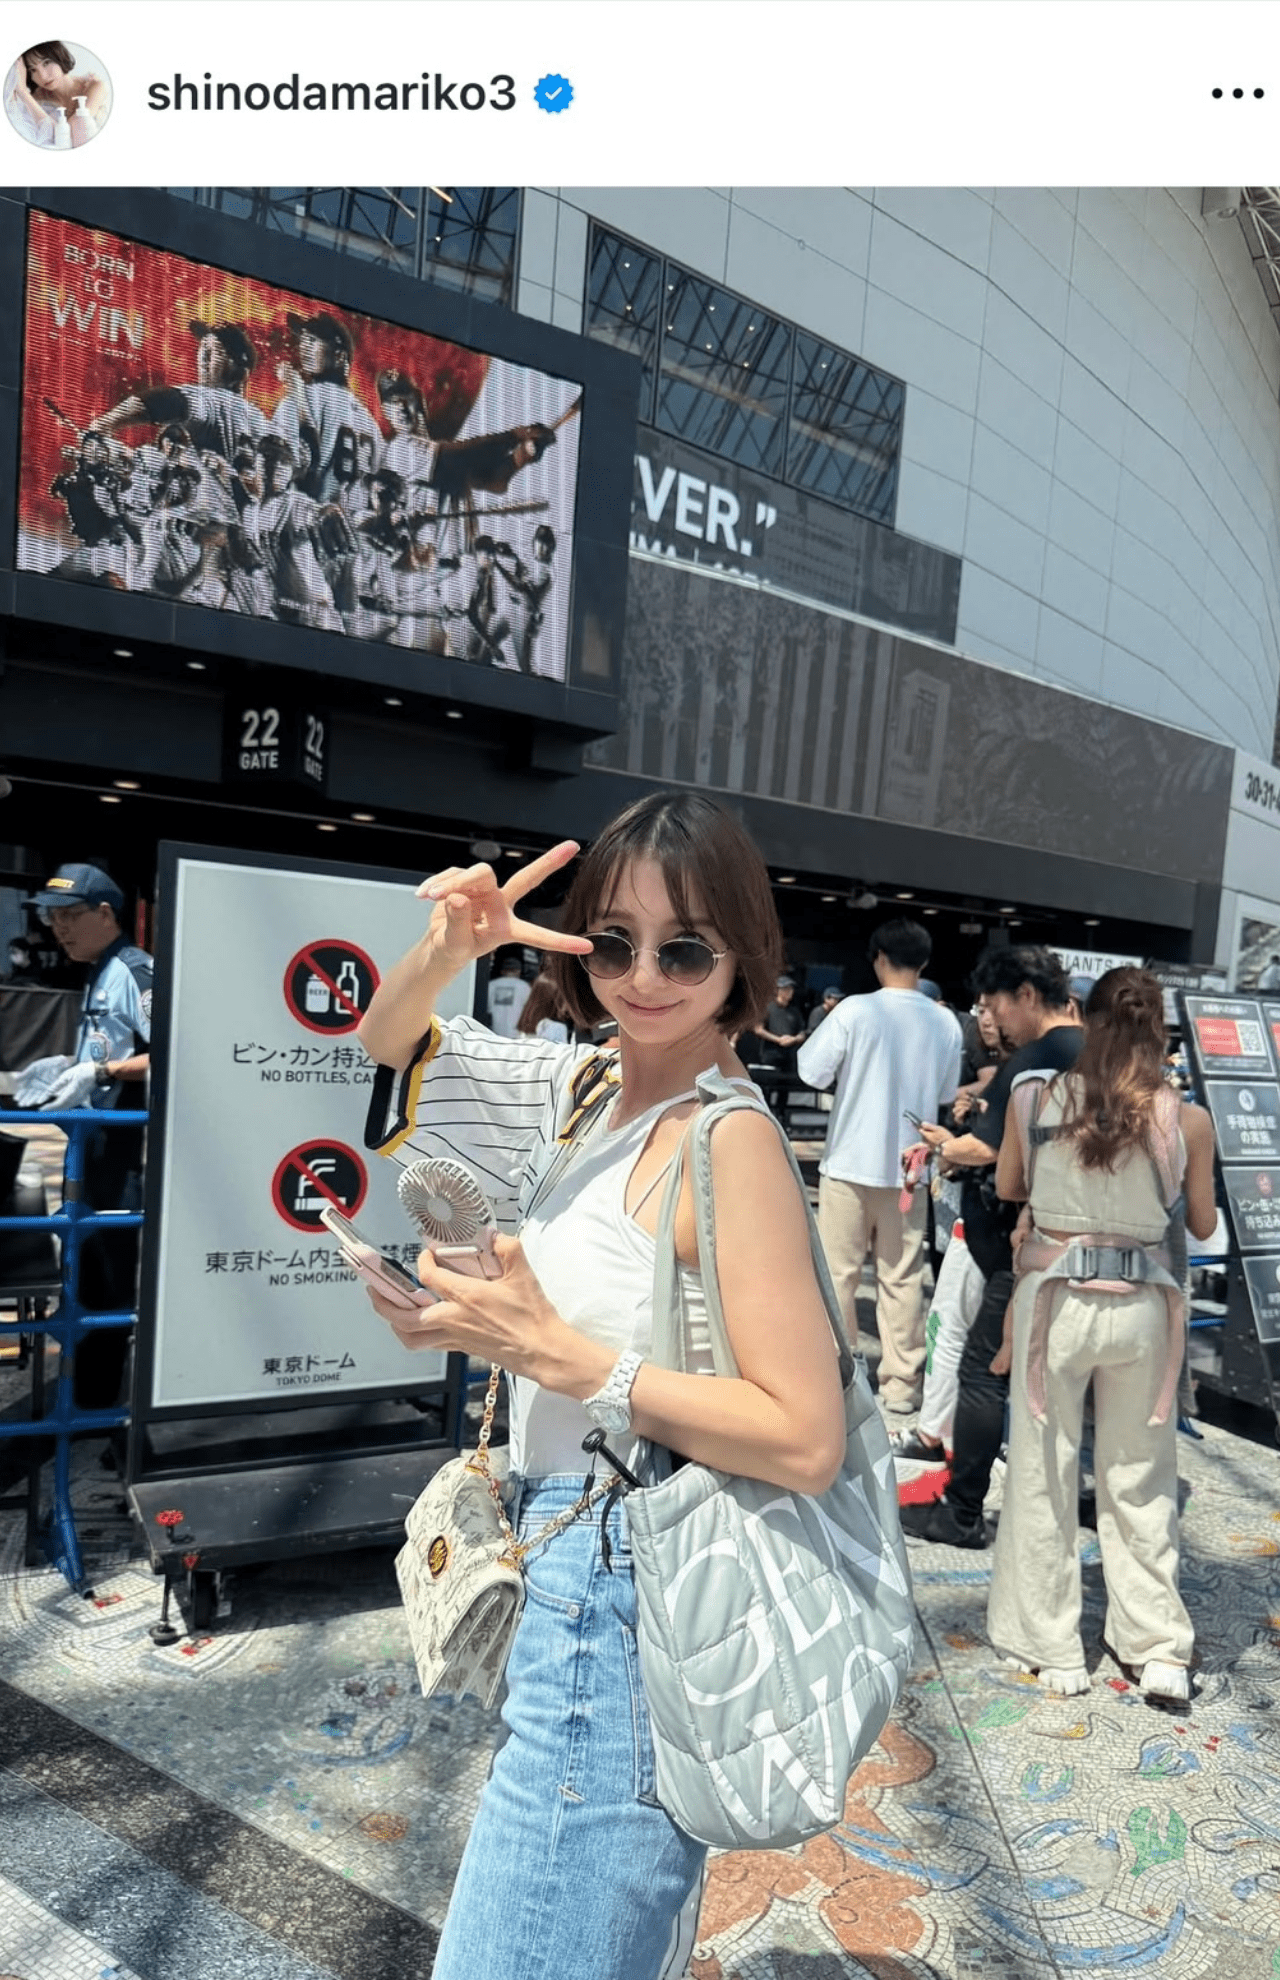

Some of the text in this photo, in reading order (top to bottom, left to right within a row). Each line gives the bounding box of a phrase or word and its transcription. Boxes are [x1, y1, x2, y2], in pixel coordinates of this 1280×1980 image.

[64, 244, 134, 281] BORN
[47, 289, 144, 349] WIN
[631, 455, 777, 558] VER.”
[241, 708, 279, 747] 22
[306, 715, 324, 759] 22
[241, 751, 278, 769] GATE
[261, 1069, 376, 1085] NO BOTTLES, CA
[269, 1270, 358, 1286] NO SMOKING
[262, 1352, 356, 1375] 東京ドーム
[276, 1372, 342, 1386] TOKYO DOME
